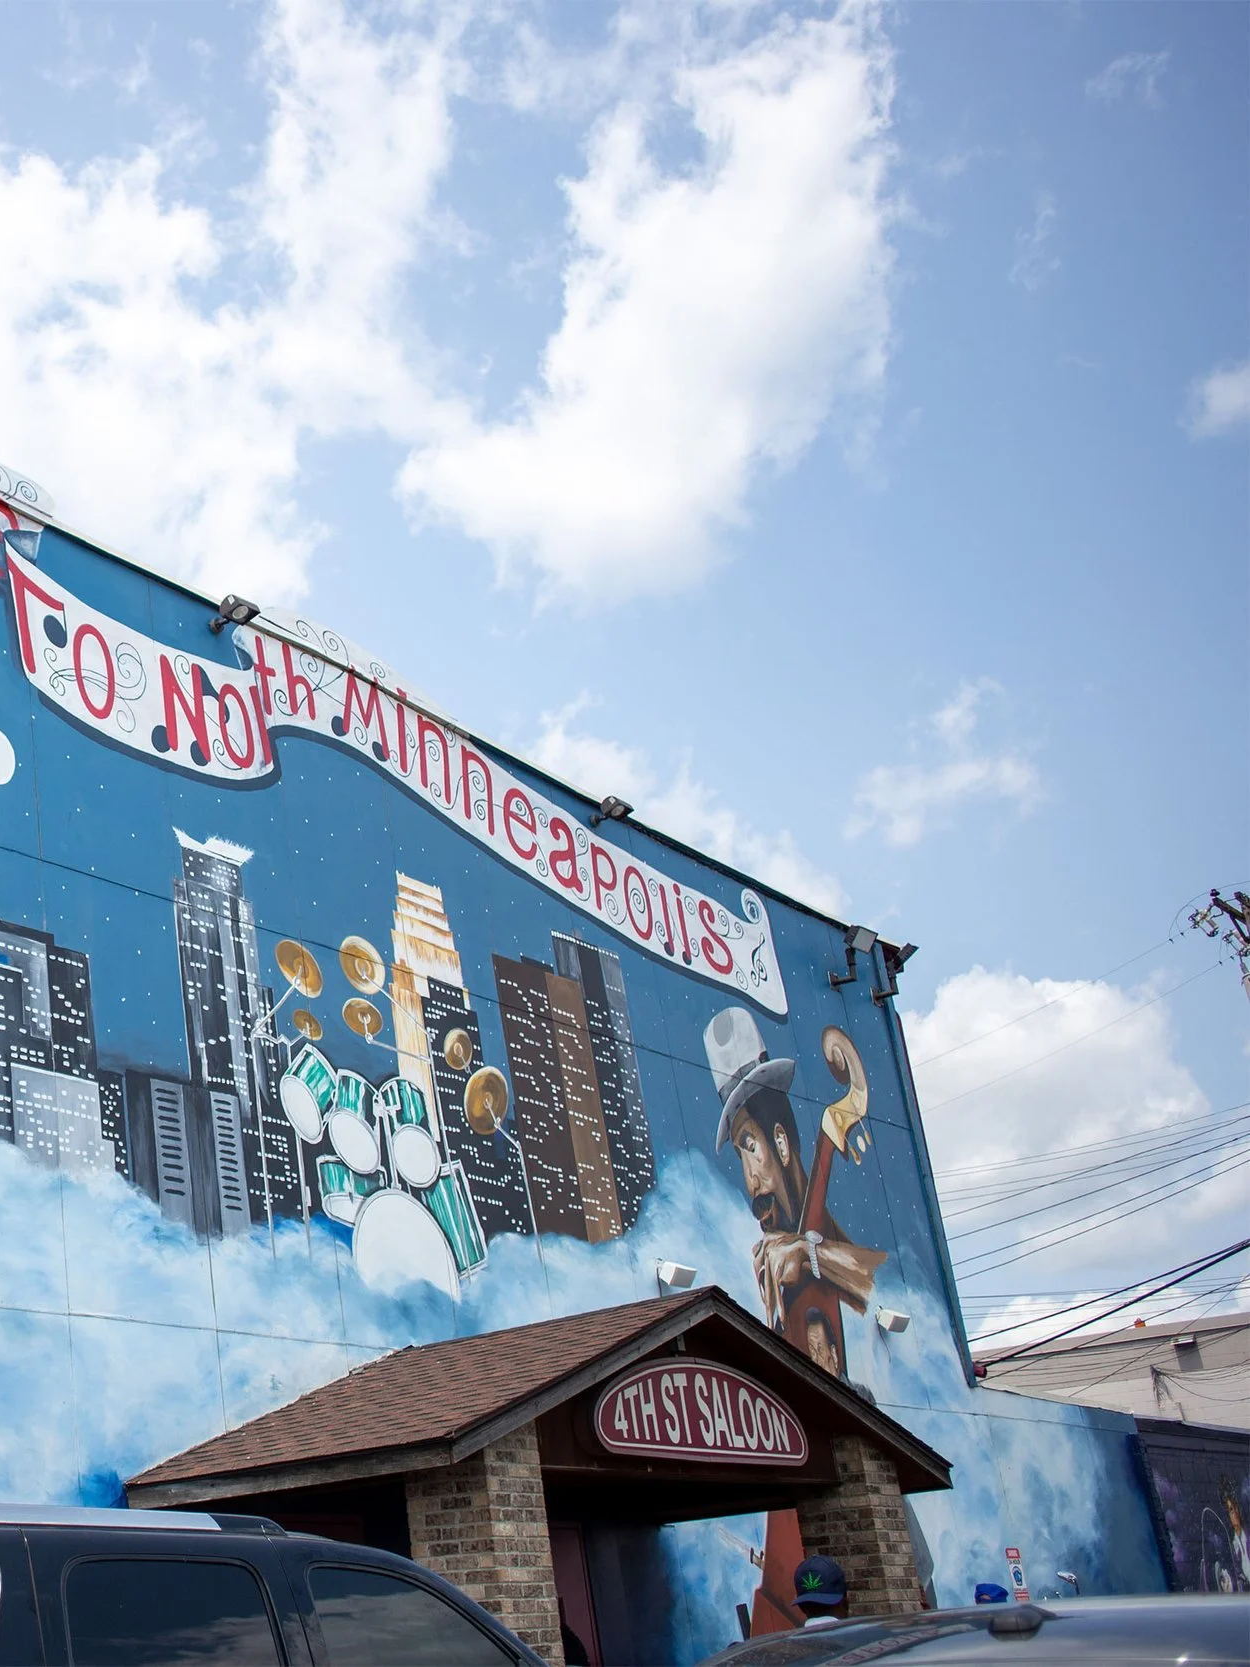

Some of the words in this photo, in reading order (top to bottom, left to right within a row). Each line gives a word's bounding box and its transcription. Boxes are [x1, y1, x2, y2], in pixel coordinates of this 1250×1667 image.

[342, 664, 734, 976] Minneapolis
[614, 1378, 661, 1442] 4TH
[660, 1373, 693, 1445] ST
[694, 1373, 791, 1452] SALOON
